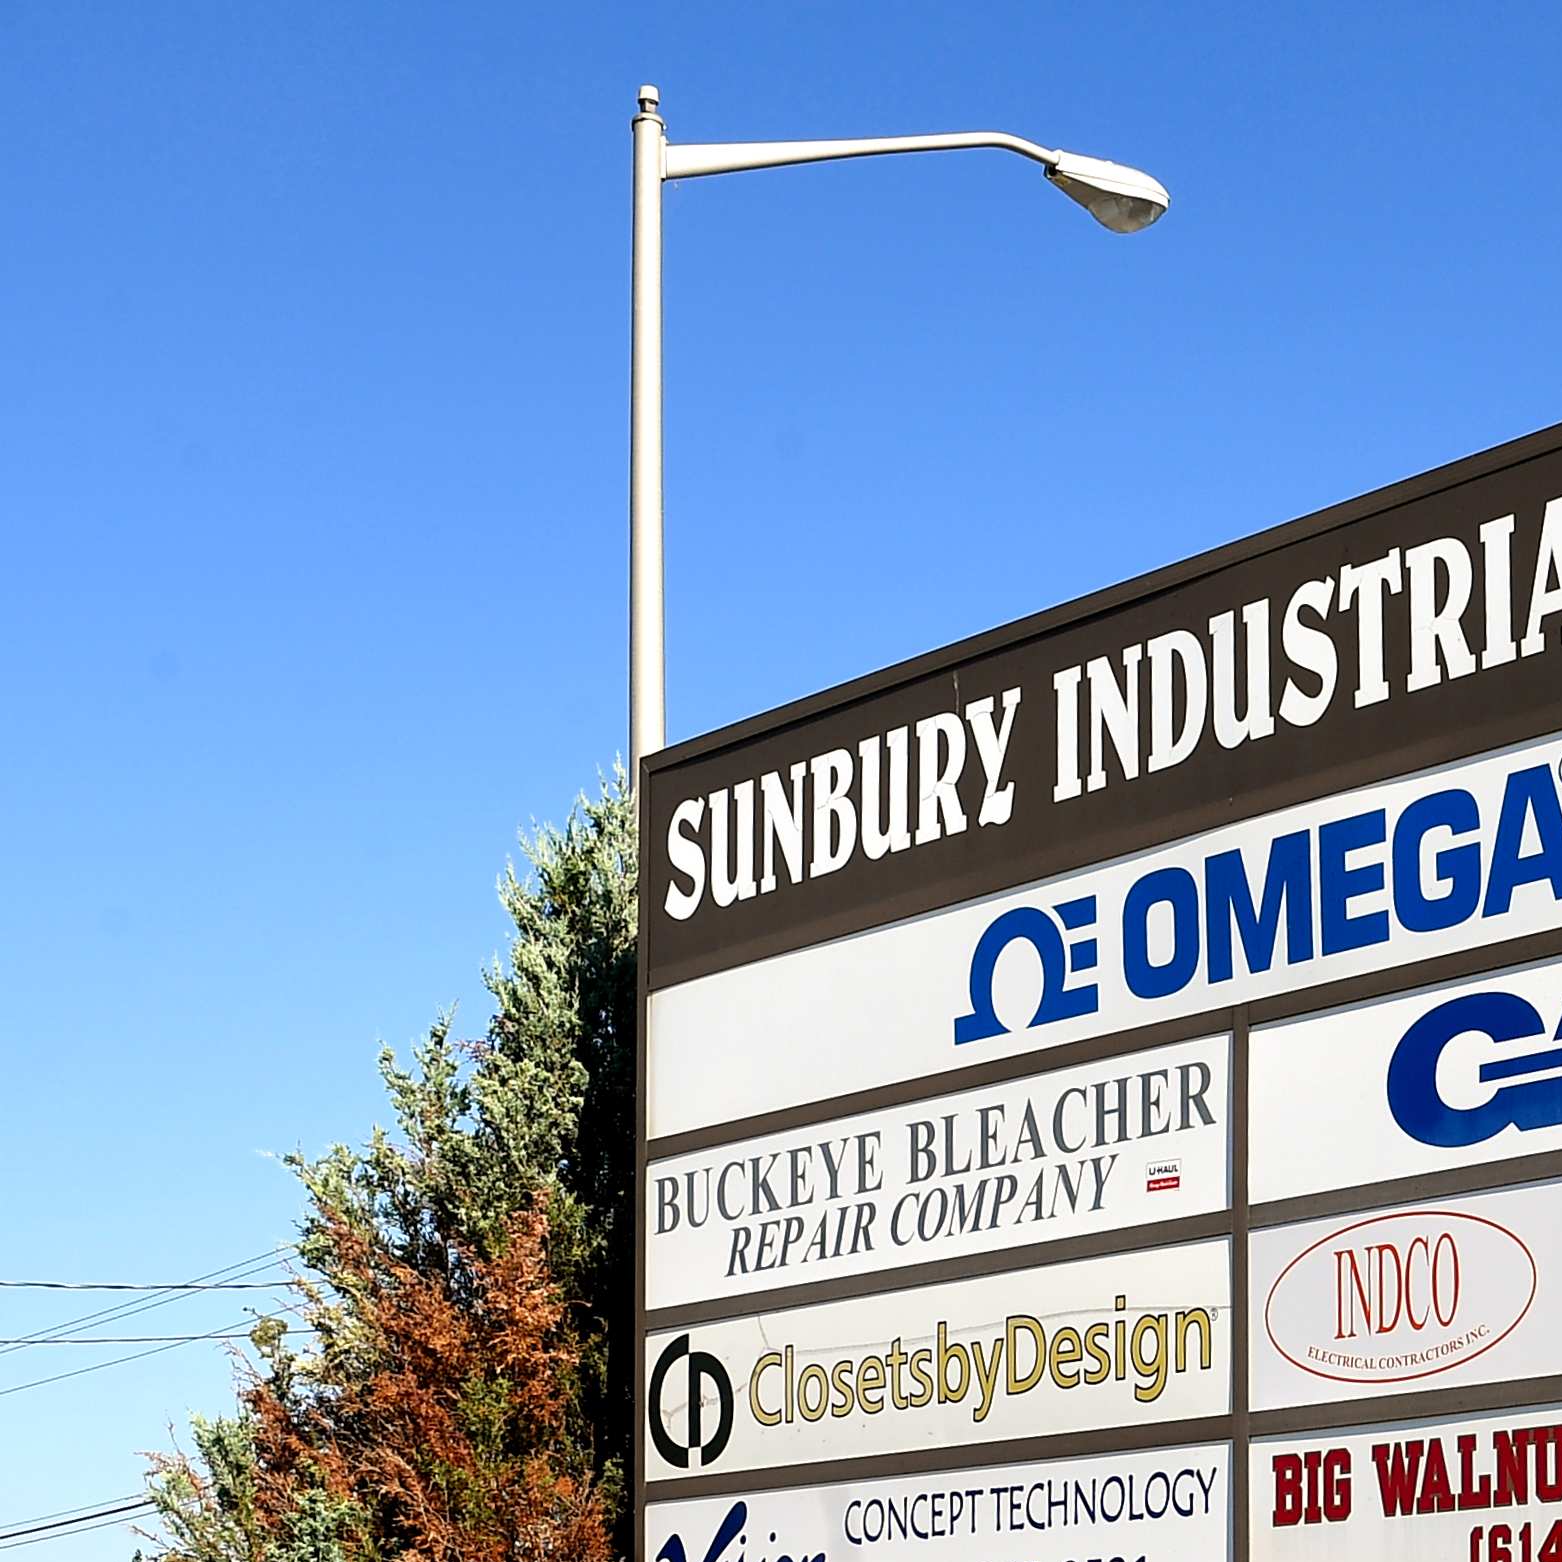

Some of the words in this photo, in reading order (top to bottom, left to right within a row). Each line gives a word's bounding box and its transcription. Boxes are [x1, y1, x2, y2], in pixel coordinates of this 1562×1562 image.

[664, 686, 1021, 920] SUNBURY
[653, 1131, 883, 1235] BUCKEYE
[906, 1061, 1216, 1184] BLEACHER
[725, 1203, 876, 1277] REPAIR
[890, 1153, 1119, 1247] COMPANY
[1334, 1233, 1459, 1339] INDCO
[1307, 1346, 1377, 1370] ELECTRICAL
[1378, 1339, 1464, 1370] CONTRACTORS
[1466, 1324, 1490, 1345] INC.
[844, 1489, 983, 1545] CONCEPT
[990, 1467, 1217, 1532] TECHNOLOGY
[1272, 1447, 1352, 1527] BIG
